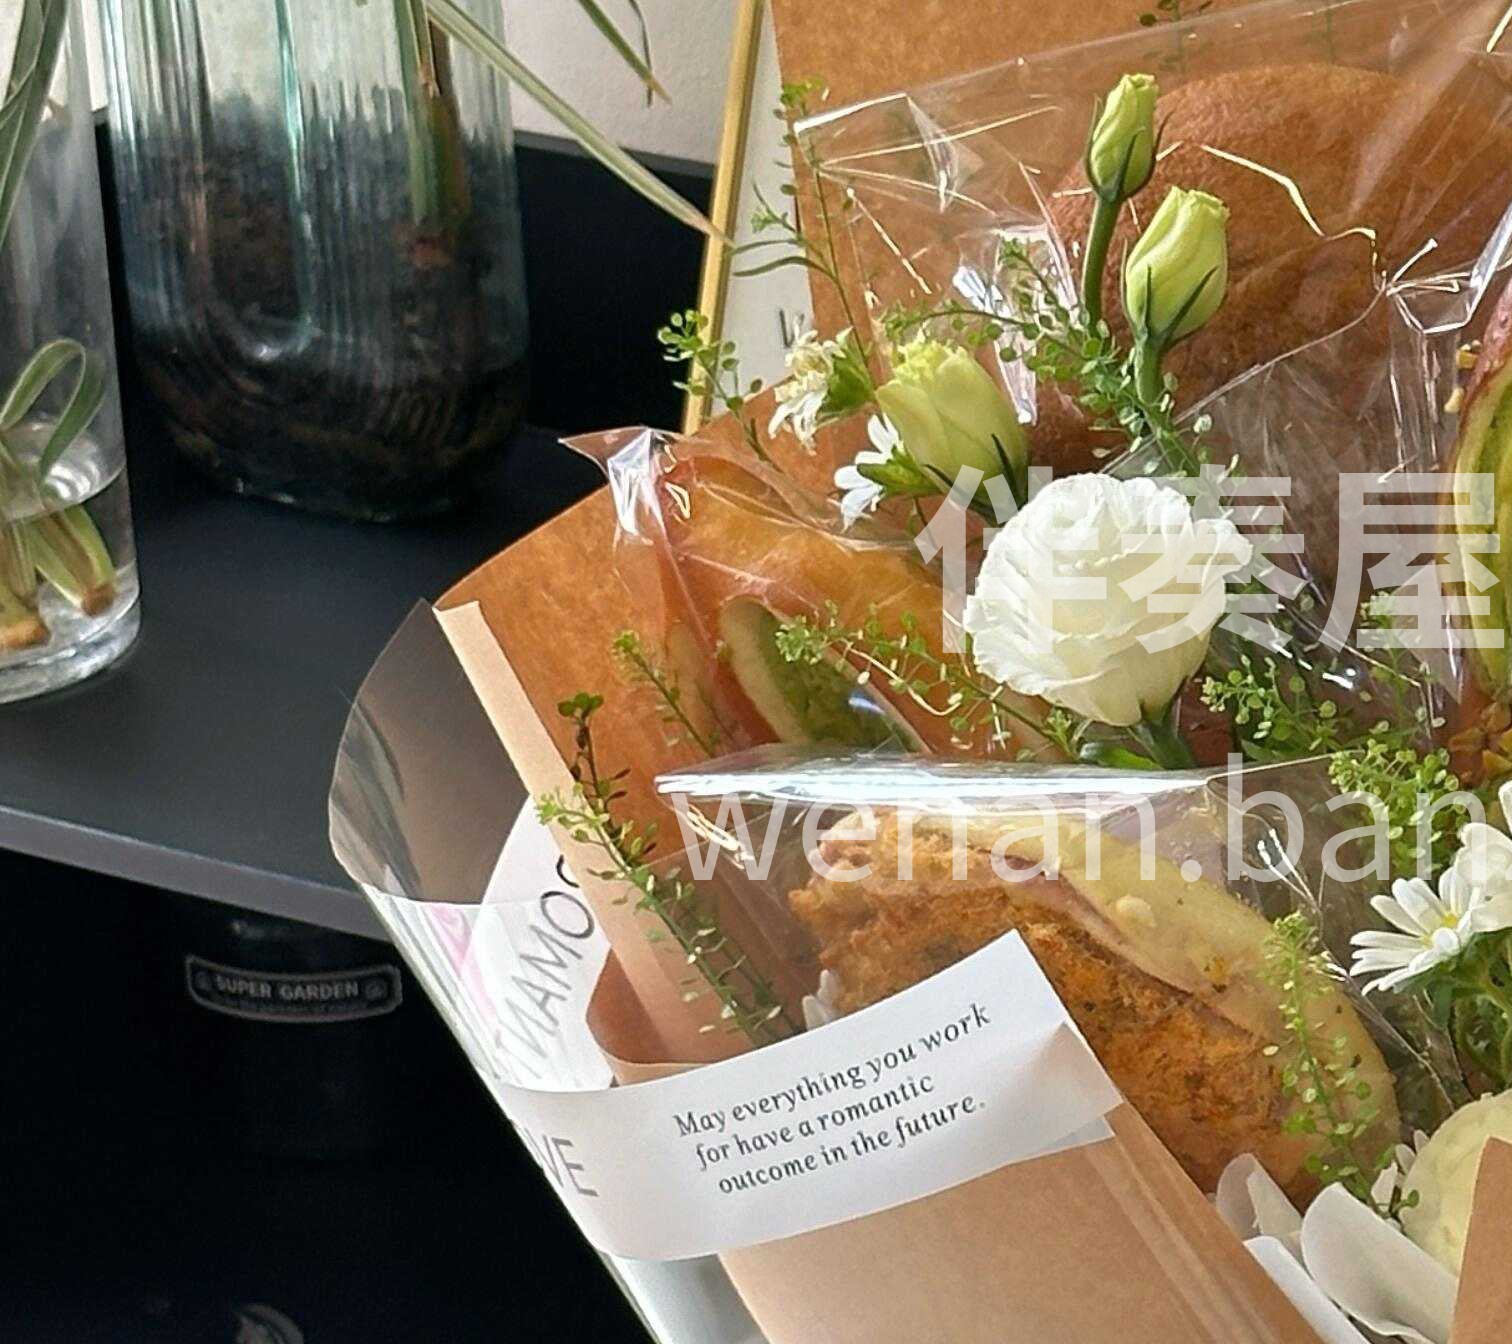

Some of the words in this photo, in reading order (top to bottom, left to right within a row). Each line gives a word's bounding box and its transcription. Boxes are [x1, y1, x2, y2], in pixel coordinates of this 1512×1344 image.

[215, 972, 272, 1000] SUPER
[277, 978, 359, 1002] GARDEN
[672, 1108, 726, 1138] May
[732, 1062, 867, 1123] everything
[866, 1042, 918, 1080] you
[920, 1002, 991, 1053] work
[696, 1142, 731, 1171] for
[736, 1123, 794, 1157] have
[799, 1119, 815, 1138] a
[817, 1073, 935, 1131] romantic
[718, 1154, 819, 1195] outcome
[823, 1142, 848, 1166] in
[851, 1127, 892, 1158] the
[895, 1090, 988, 1149] future.
